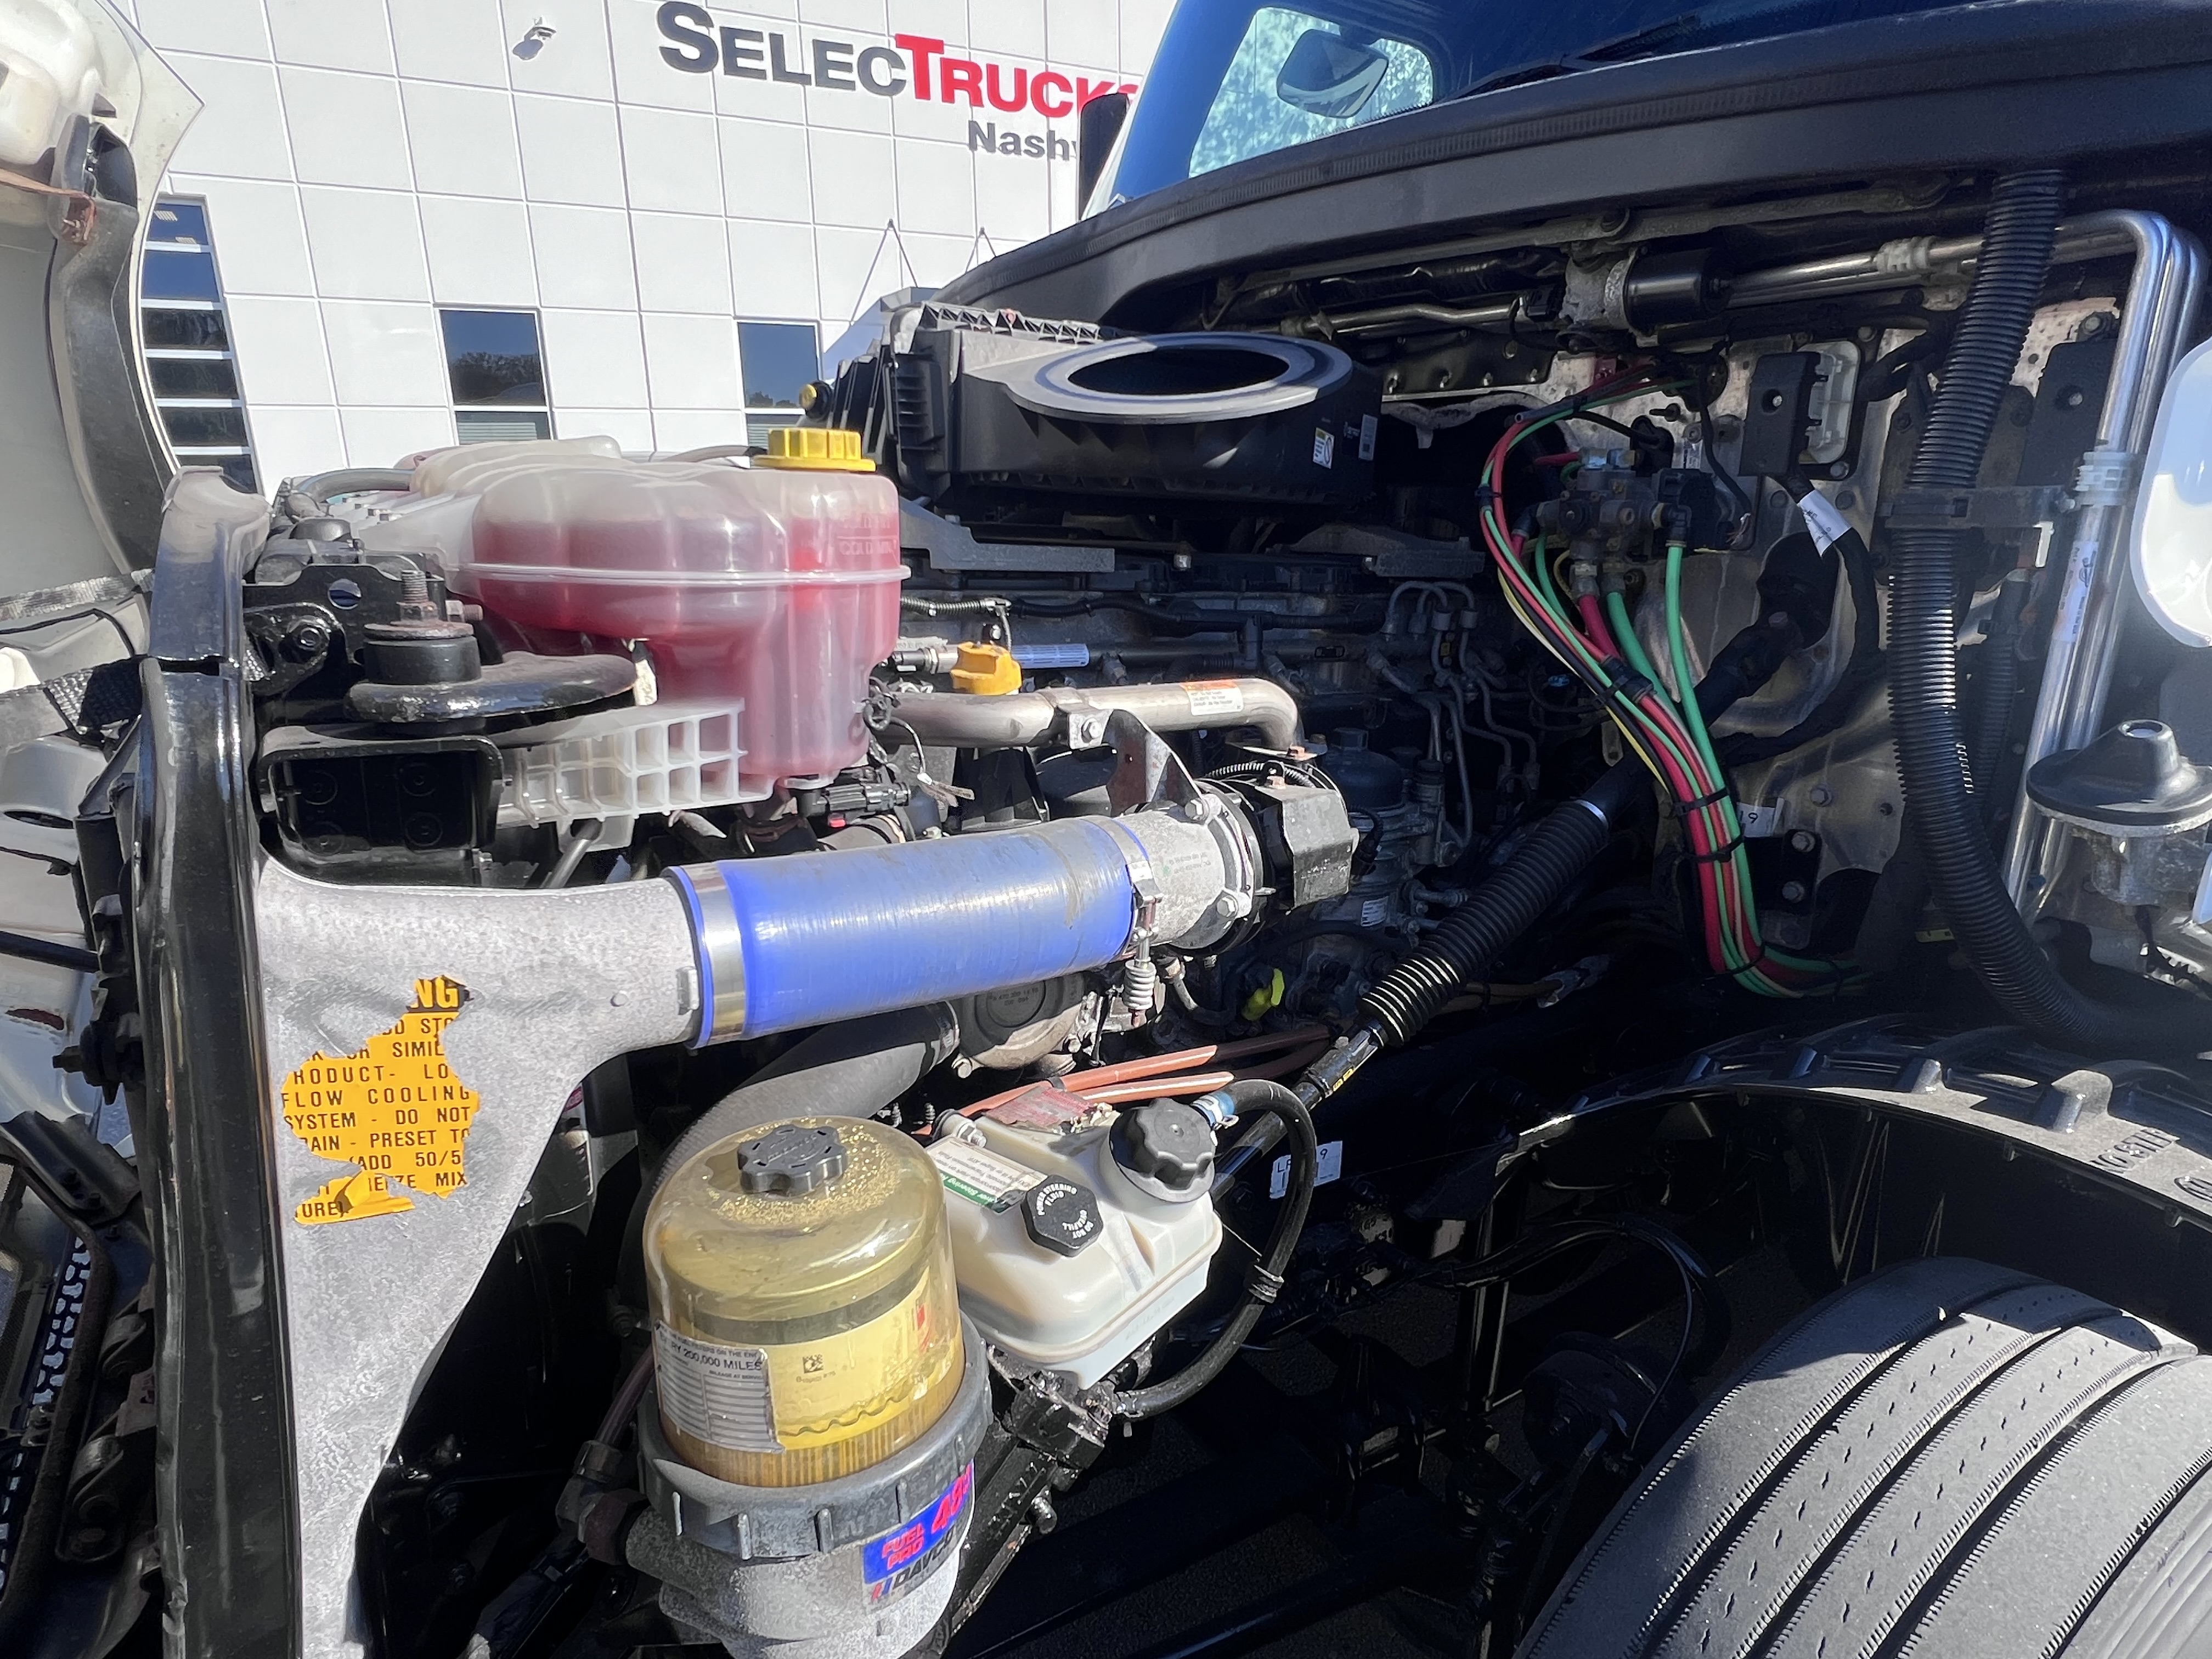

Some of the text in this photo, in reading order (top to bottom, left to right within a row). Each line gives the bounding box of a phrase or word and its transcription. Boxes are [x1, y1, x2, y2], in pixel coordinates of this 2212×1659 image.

[656, 1, 1139, 118] SELECTRUCK
[424, 1063, 456, 1079] LO
[281, 1085, 470, 1108] FLOW COOLING
[284, 1112, 356, 1130] SYSTEM
[396, 1109, 418, 1125] DO
[437, 1106, 471, 1123] NOT
[370, 1130, 437, 1148] PRESET
[436, 1172, 467, 1187] MIX
[295, 1200, 344, 1218] URE)
[683, 1348, 721, 1368] 200,000
[724, 1359, 763, 1371] MILES
[881, 1522, 925, 1559] FUEL
[887, 1537, 925, 1571] PRO
